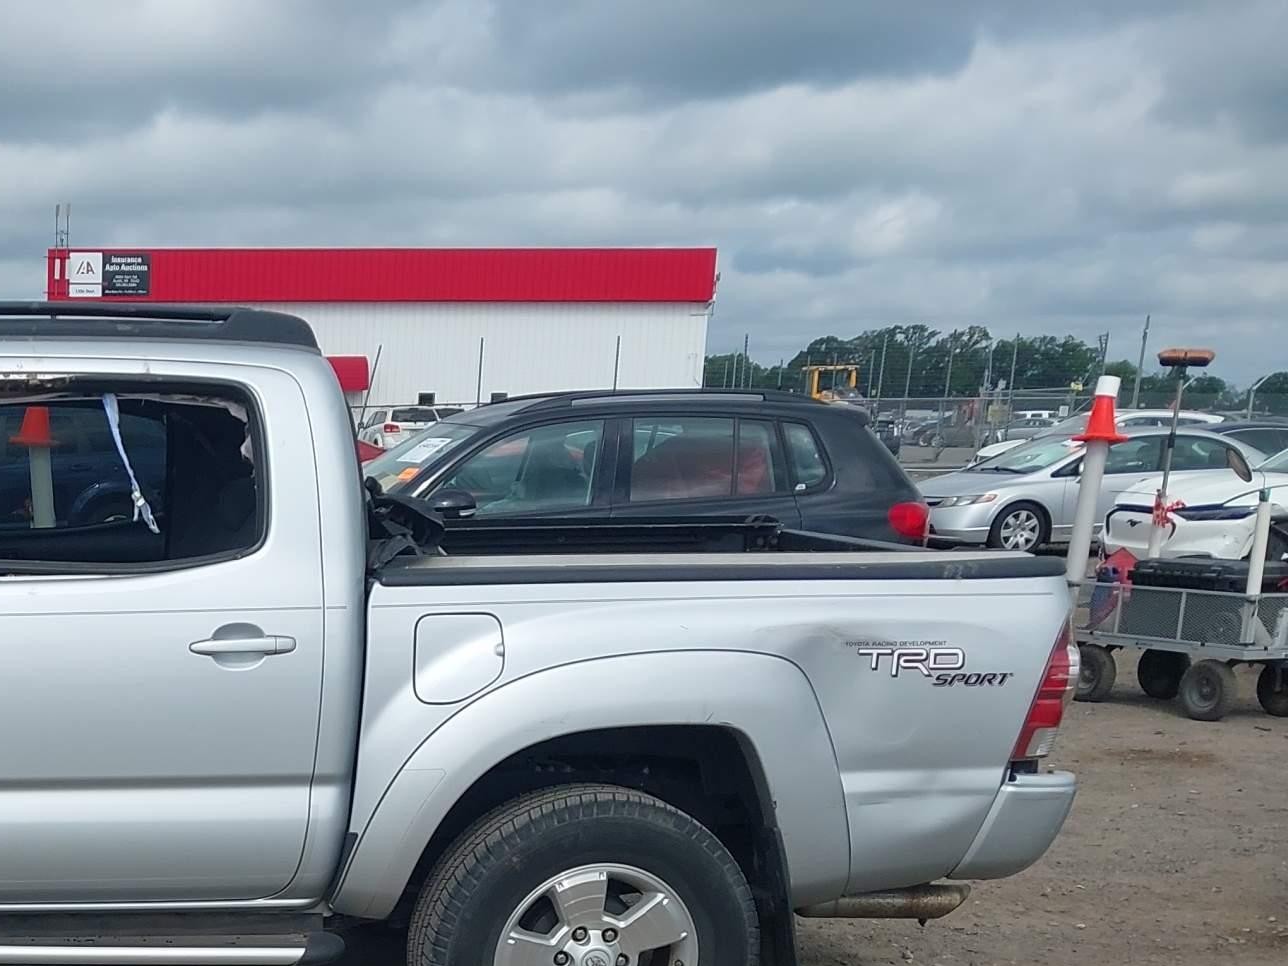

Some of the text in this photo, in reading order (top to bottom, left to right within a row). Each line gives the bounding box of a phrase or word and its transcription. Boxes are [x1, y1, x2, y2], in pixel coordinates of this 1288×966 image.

[111, 255, 142, 263] Insurance
[857, 647, 965, 678] TRD
[932, 672, 1010, 687] SPORT
